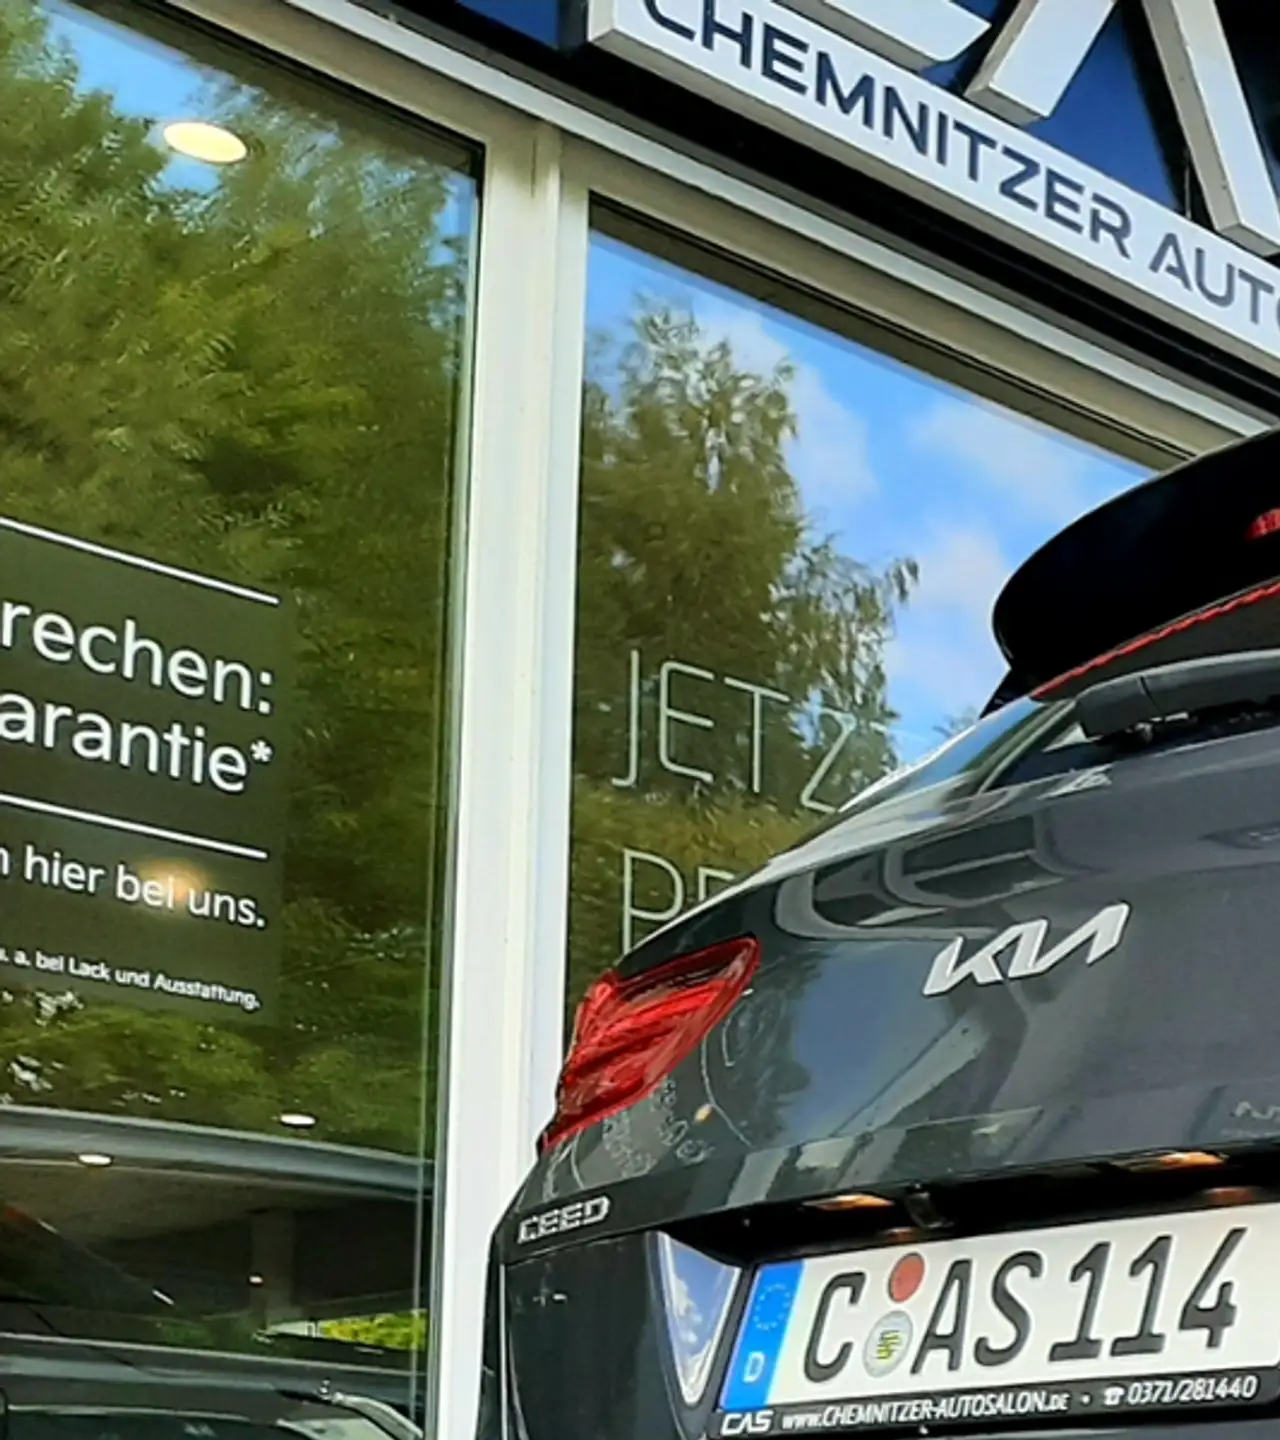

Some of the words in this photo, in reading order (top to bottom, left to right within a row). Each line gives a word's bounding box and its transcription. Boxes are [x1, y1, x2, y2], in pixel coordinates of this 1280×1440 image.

[1, 600, 273, 715] rechen:
[611, 649, 930, 813] JETZ
[24, 844, 106, 894] hier
[115, 863, 175, 909] bei
[188, 886, 266, 929] uns.
[35, 950, 64, 973] bei
[69, 956, 112, 981] Lack
[115, 968, 150, 989] und
[921, 902, 1130, 996] KIA
[742, 1352, 764, 1383] D
[803, 1271, 866, 1384] C
[720, 1408, 774, 1436] CAS
[1127, 1374, 1259, 1405] 0371/281440
